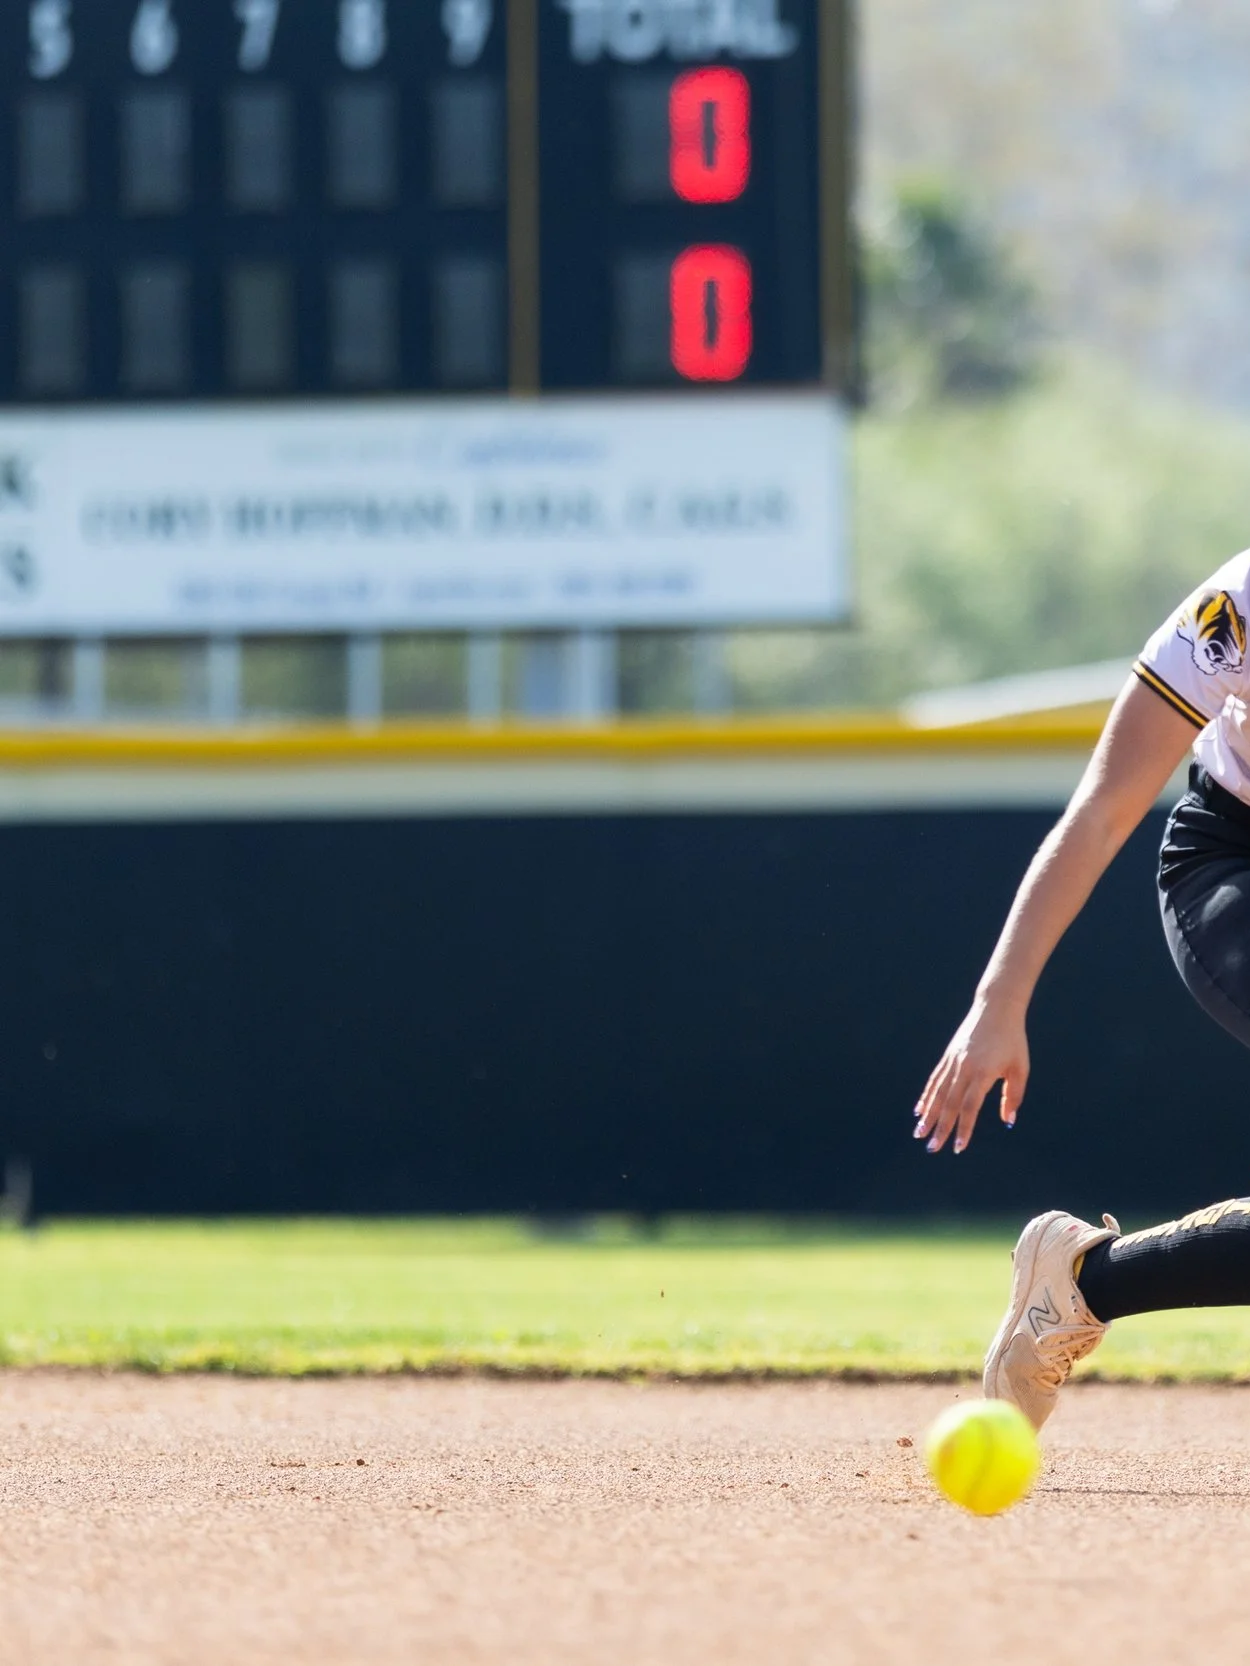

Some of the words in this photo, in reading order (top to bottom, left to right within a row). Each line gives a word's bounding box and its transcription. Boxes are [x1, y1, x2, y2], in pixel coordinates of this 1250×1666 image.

[28, 0, 73, 79] 5
[129, 0, 179, 75] 6
[234, 0, 281, 72] 7
[336, 0, 388, 70] 8
[440, 0, 492, 67] 9
[558, 0, 799, 62] TOTAL
[669, 66, 750, 203] 0
[670, 244, 752, 381] 0
